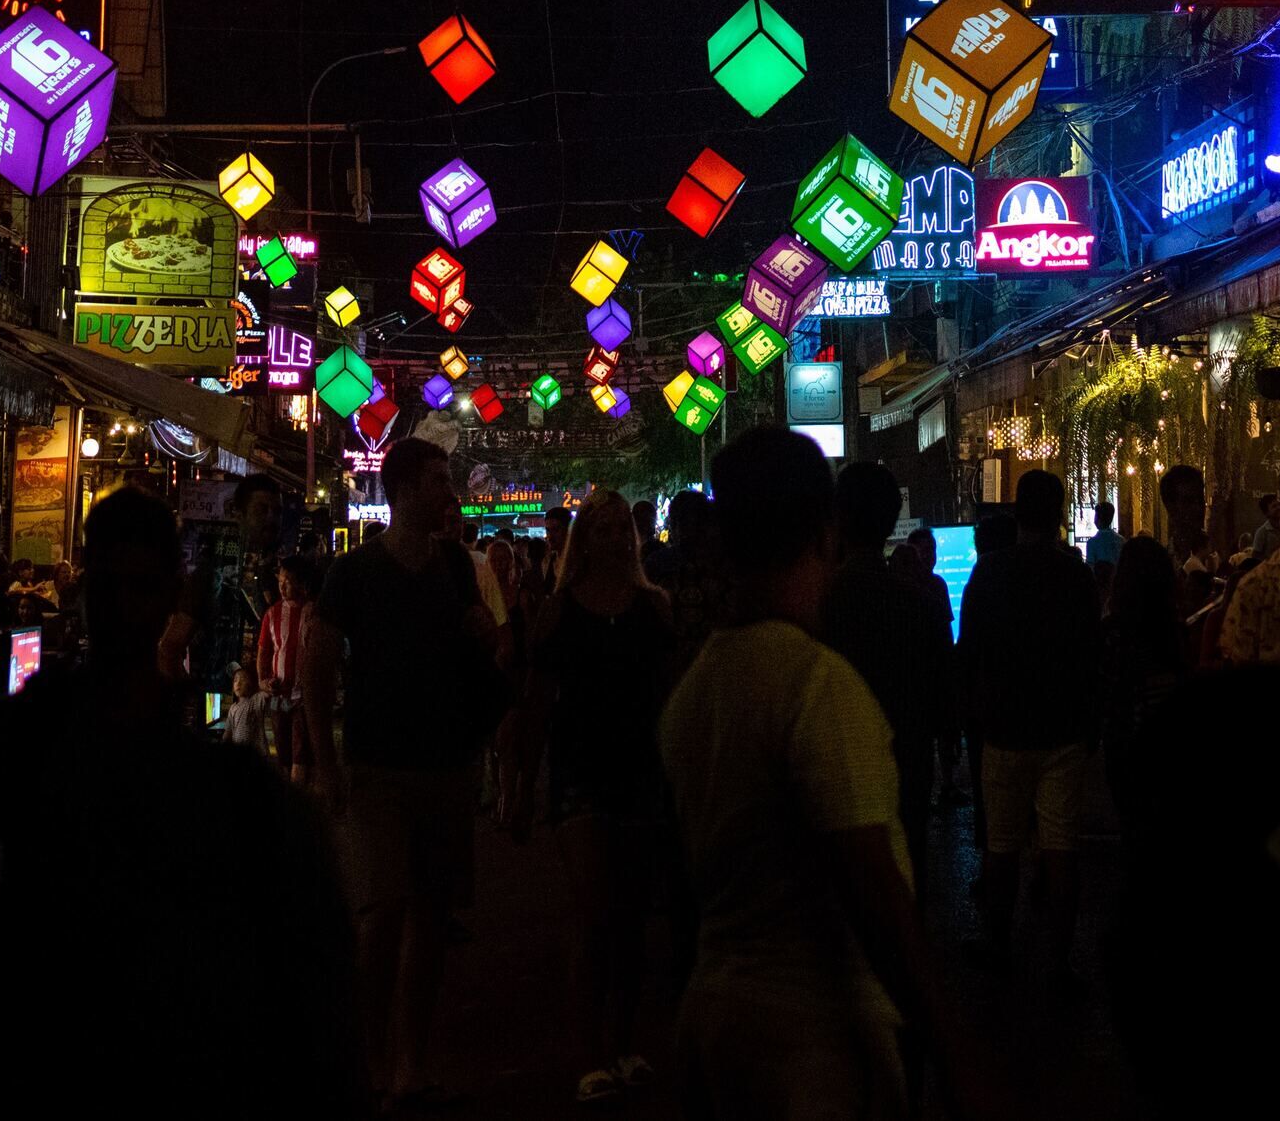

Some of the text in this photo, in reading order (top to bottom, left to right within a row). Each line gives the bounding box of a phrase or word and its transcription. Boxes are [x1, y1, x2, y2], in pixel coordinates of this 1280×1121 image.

[950, 7, 1011, 59] TEMPLE
[979, 32, 1006, 55] Club
[10, 27, 71, 87] 16
[36, 56, 83, 96] years
[912, 63, 955, 133] 16
[821, 196, 865, 250] 16
[840, 221, 873, 254] years
[775, 248, 810, 276] 16
[976, 229, 1095, 267] Angkor
[751, 280, 777, 319] 16
[76, 312, 234, 354] PIZZERIA
